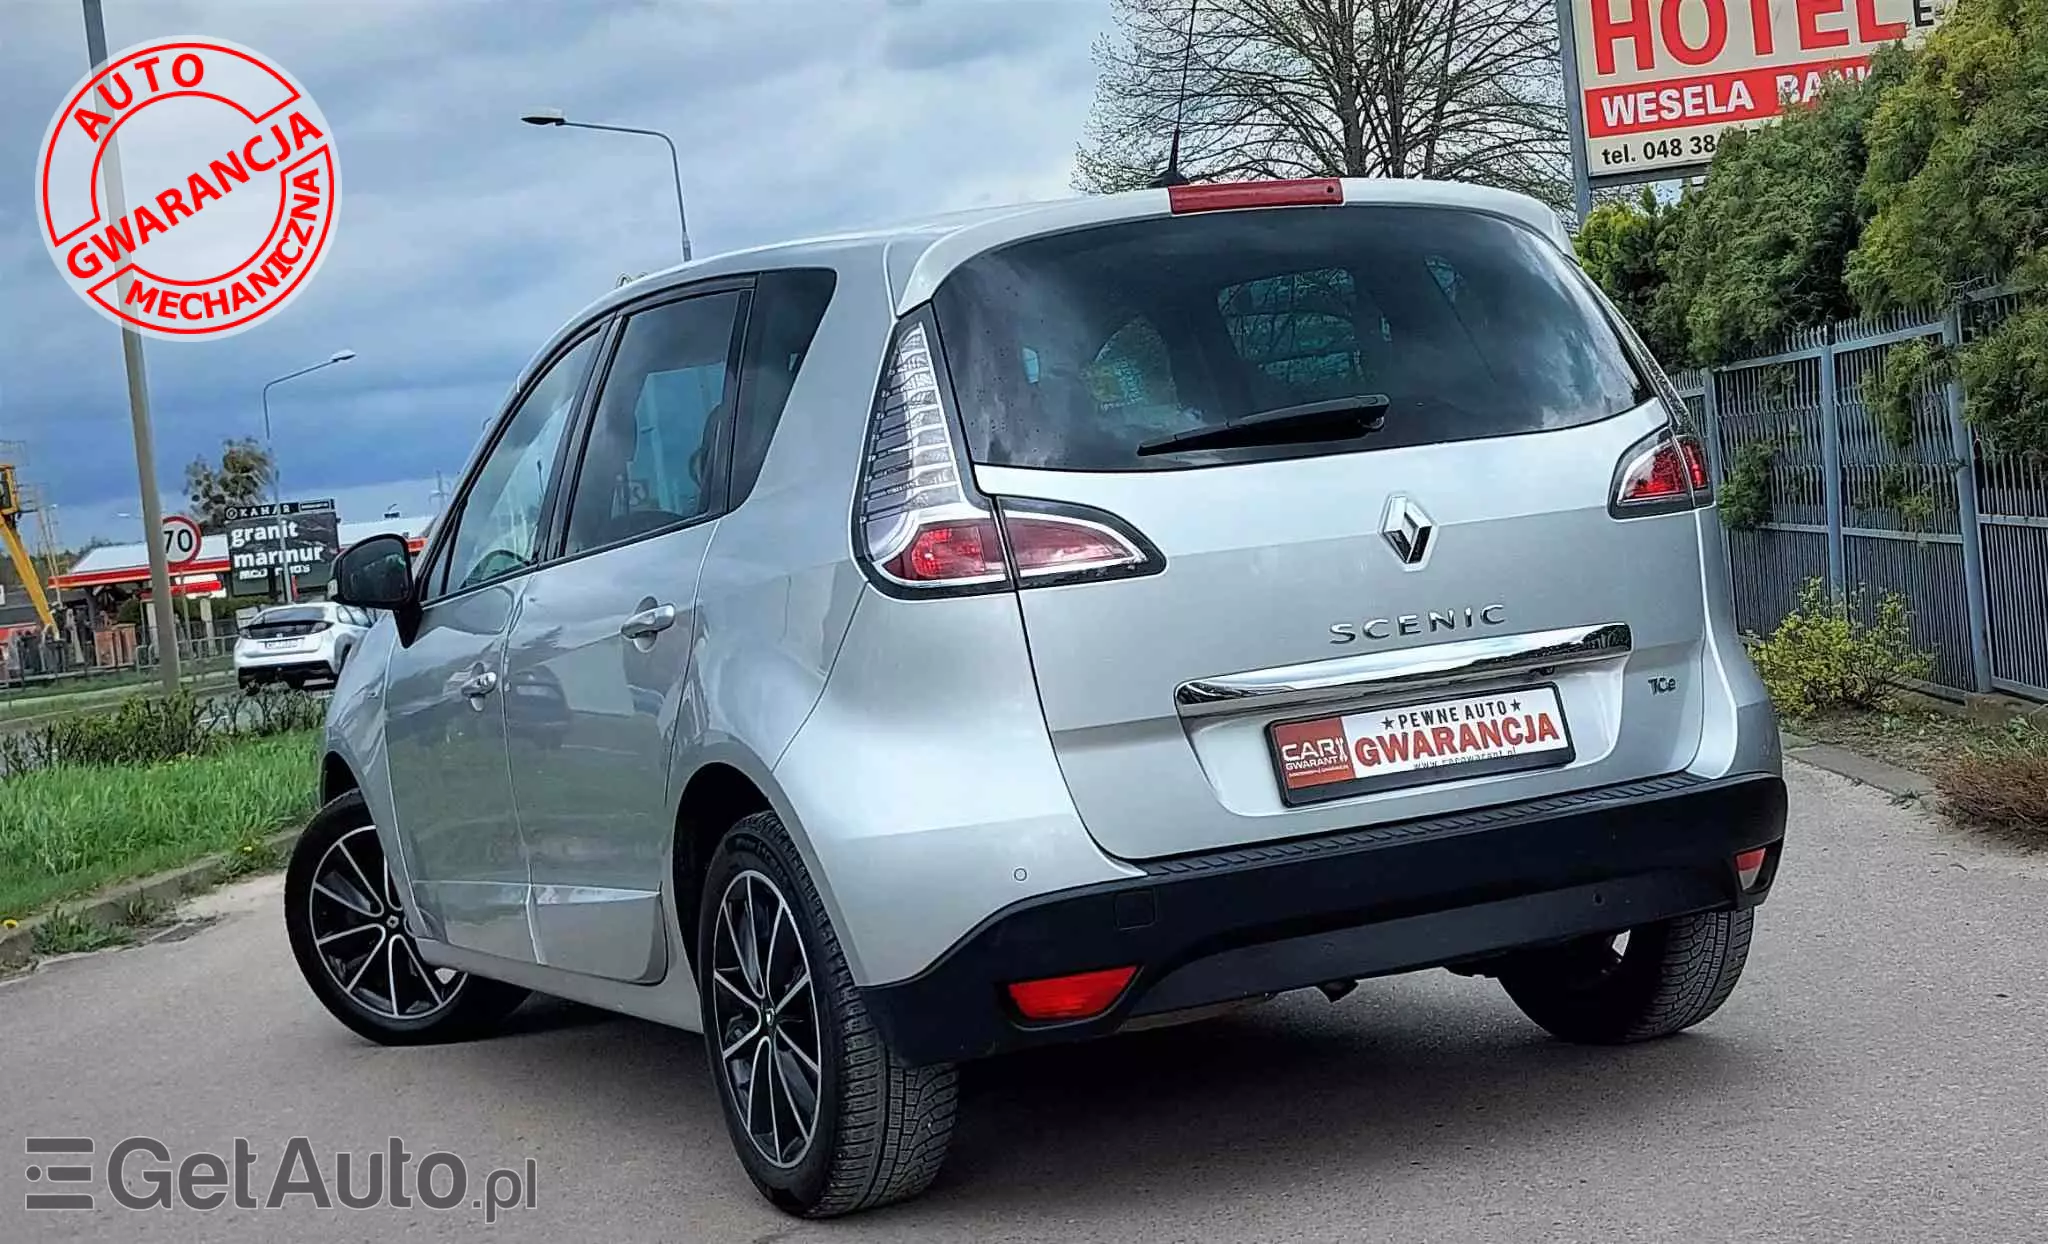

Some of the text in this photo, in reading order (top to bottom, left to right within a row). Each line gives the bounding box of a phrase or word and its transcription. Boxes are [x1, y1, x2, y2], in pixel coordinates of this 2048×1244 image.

[1592, 0, 1907, 75] HOTEL
[1601, 80, 1754, 127] WESELA
[1602, 134, 1722, 165] tel. 048 38
[163, 529, 192, 553] 70
[231, 520, 299, 548] granit
[233, 546, 324, 568] marmur
[1329, 604, 1506, 645] SCENIC
[1399, 700, 1506, 730] PEWNE AUTO
[1281, 738, 1337, 762] CAR
[1354, 712, 1560, 767] GWARANCJA
[1285, 755, 1338, 771] GWARANT
